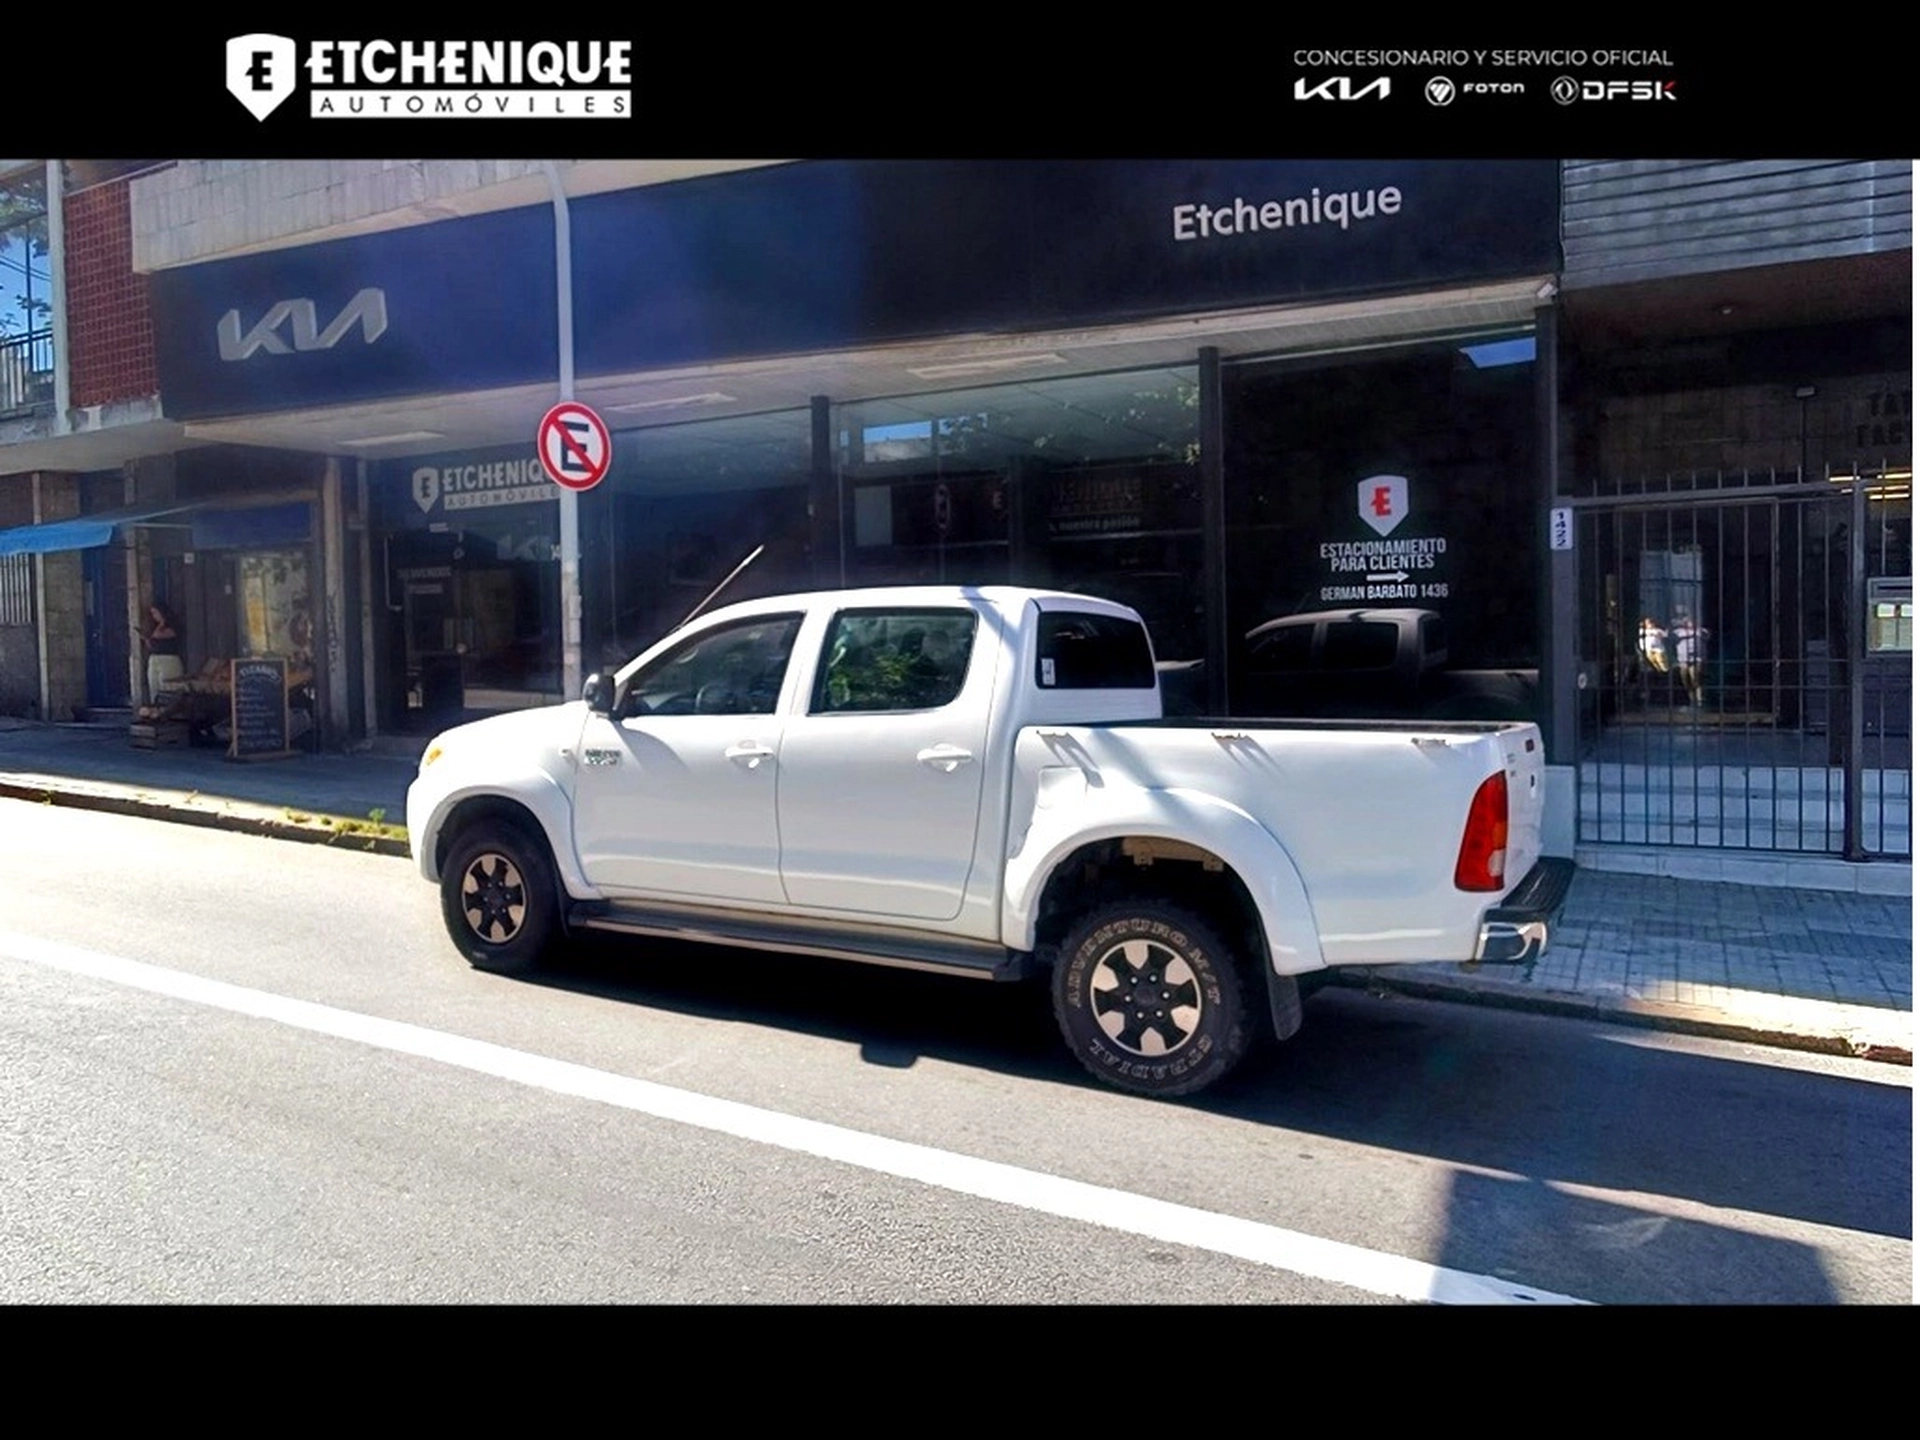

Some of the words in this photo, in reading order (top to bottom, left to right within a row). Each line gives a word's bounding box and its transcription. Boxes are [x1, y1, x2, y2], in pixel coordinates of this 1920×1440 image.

[1173, 186, 1402, 241] Etchenique
[216, 288, 388, 362] KIA
[447, 486, 560, 506] AUTOMÓVILE
[1320, 538, 1447, 559] ESTACIONAMIENTO
[1331, 557, 1367, 572] PARA
[1370, 553, 1435, 570] CLIENTES
[1321, 586, 1365, 601] GERMAN
[1367, 584, 1418, 599] BARBATO
[1421, 583, 1449, 597] 1436
